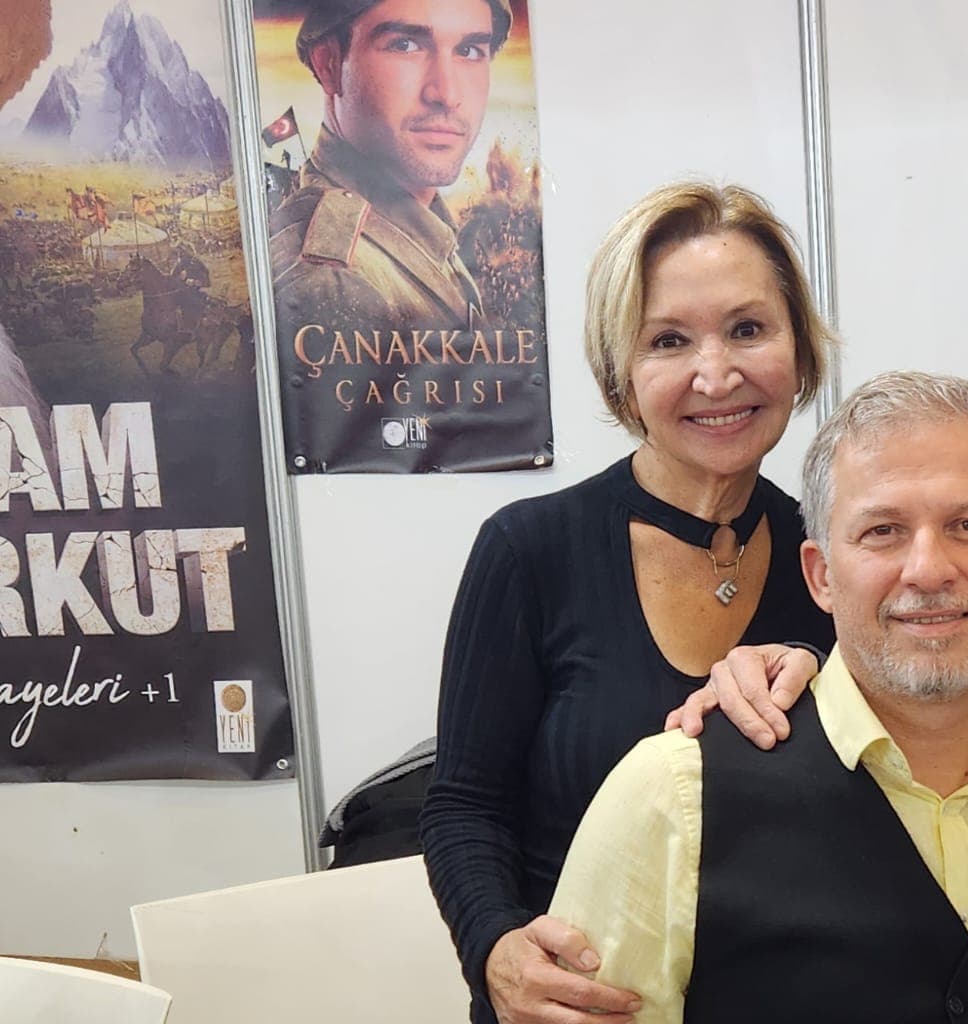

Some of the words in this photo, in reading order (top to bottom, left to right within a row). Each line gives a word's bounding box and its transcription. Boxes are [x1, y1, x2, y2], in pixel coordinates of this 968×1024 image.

[294, 324, 538, 378] ÇANAKKALE
[335, 372, 504, 411] ÇAĞRISI
[141, 672, 180, 703] +1
